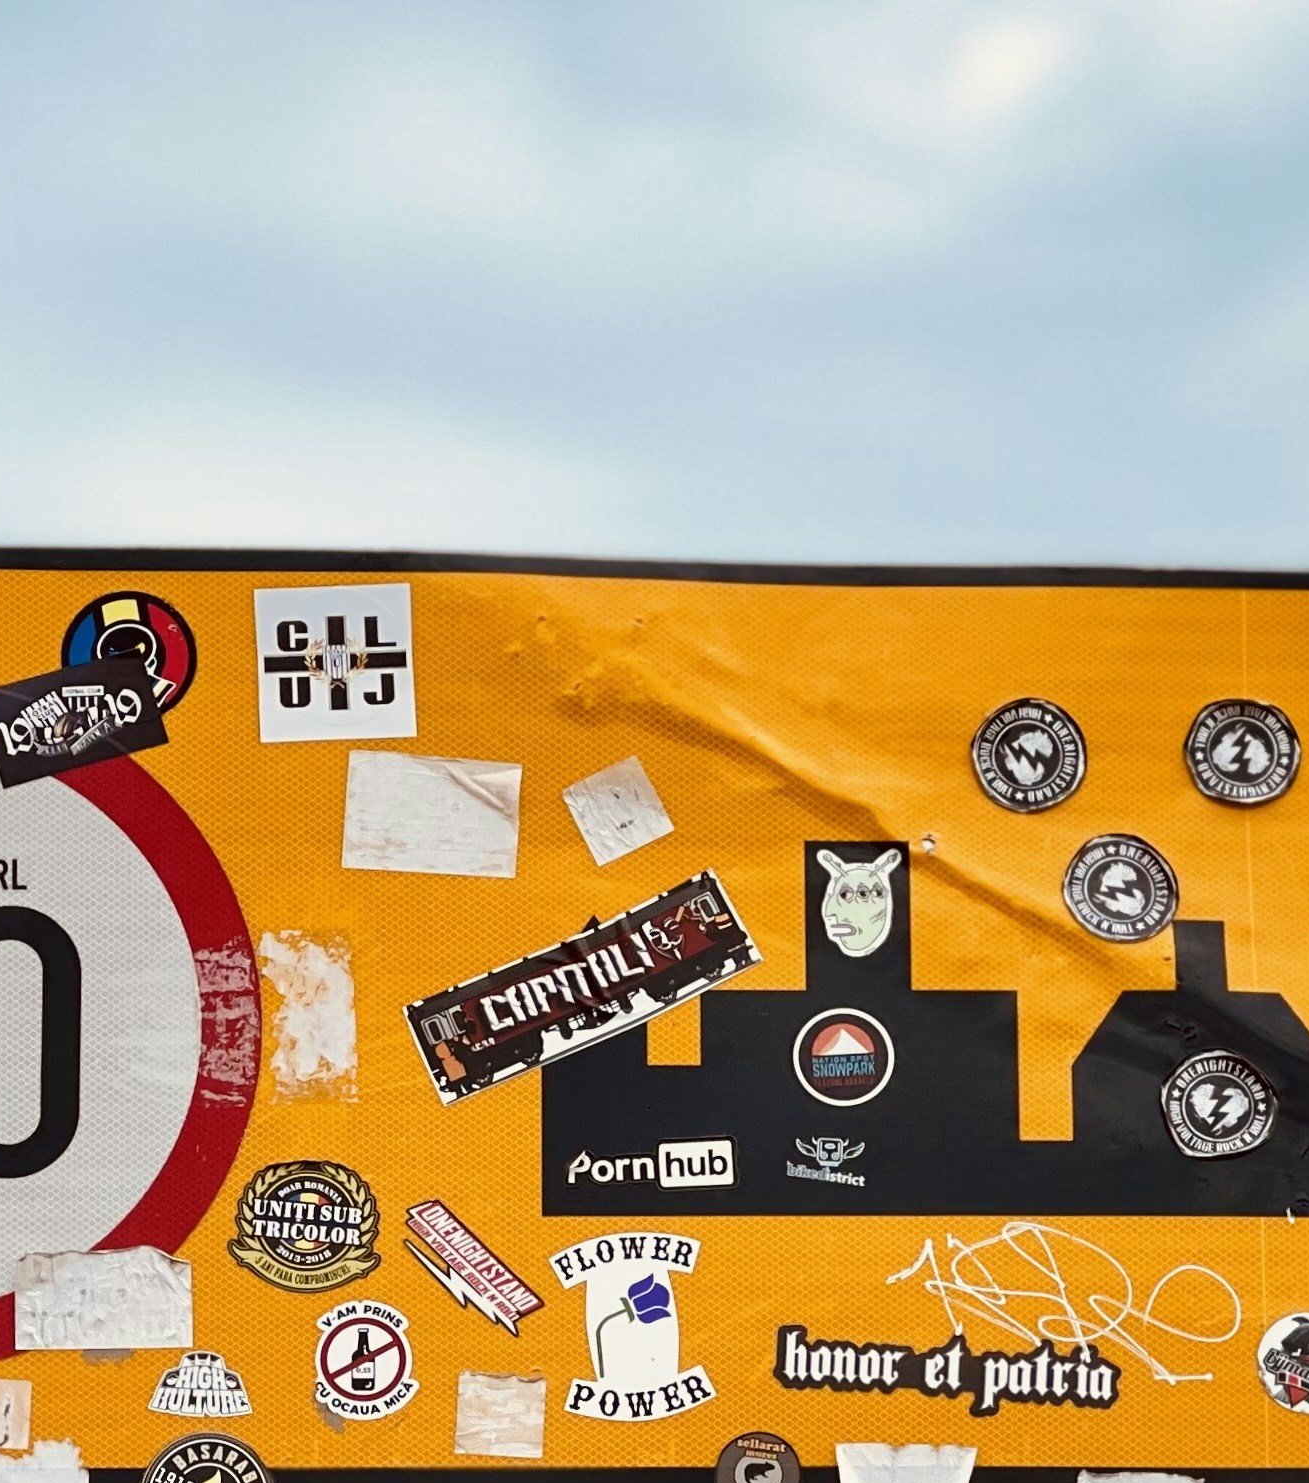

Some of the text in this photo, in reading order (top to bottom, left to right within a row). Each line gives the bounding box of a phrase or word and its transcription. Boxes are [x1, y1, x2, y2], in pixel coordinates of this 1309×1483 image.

[812, 1062, 875, 1077] SNOWPARK
[319, 1204, 363, 1225] SUB
[252, 1219, 362, 1246] TRICOLOR
[421, 1204, 539, 1312] ONENIGHTSTAND
[559, 1235, 695, 1281] FLOWER
[321, 1304, 404, 1331] V-AM PRINS
[176, 1365, 228, 1390] HIGH
[783, 1331, 1114, 1409] honor et patria
[152, 1388, 253, 1415] KULTURE
[331, 1394, 381, 1417] OCAUA
[571, 1376, 712, 1418] POWER
[737, 1438, 786, 1453] sellarat
